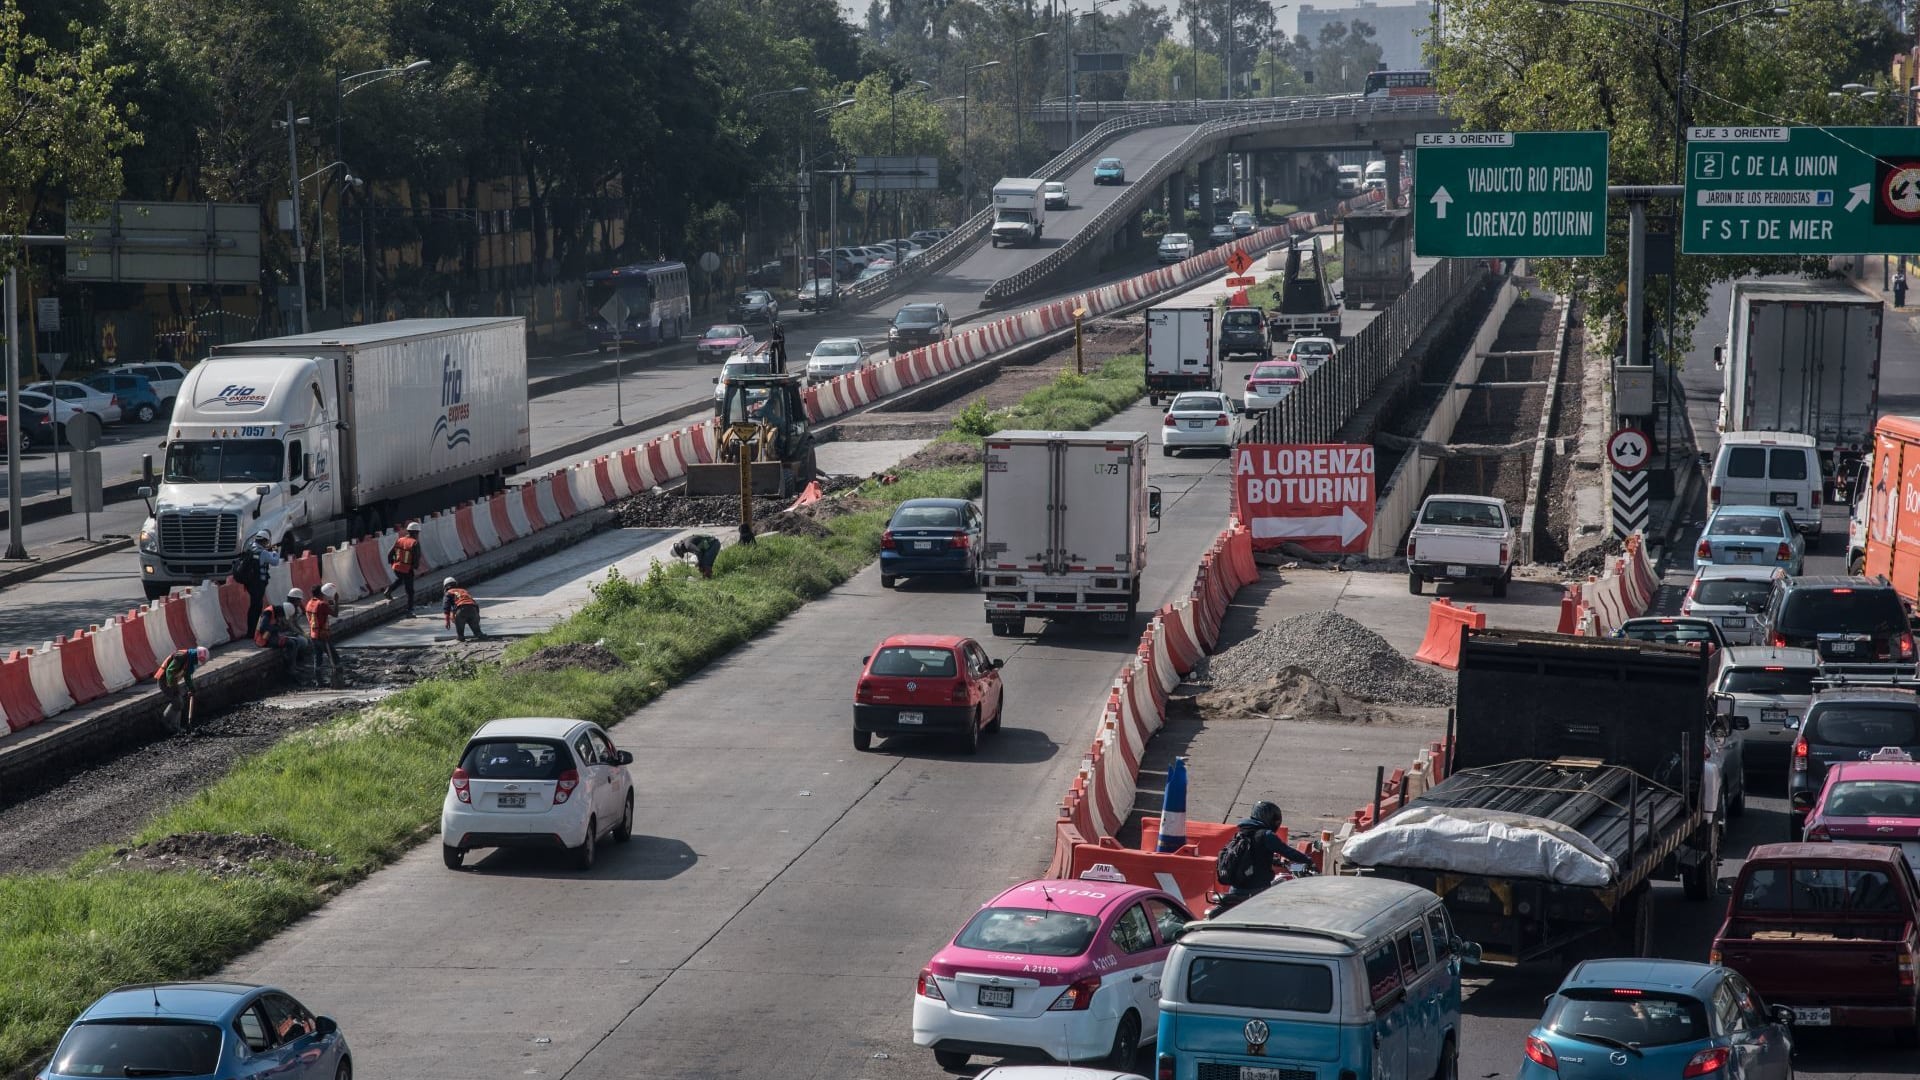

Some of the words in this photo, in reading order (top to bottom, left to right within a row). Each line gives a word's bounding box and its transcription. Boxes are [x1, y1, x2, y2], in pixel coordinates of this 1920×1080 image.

[1422, 135, 1443, 144] EJE
[1448, 136, 1456, 144] 3
[1460, 135, 1505, 144] ORIENTE
[1695, 129, 1716, 138] EJE
[1721, 129, 1729, 138] 3
[1734, 129, 1781, 138] ORIENTE
[1703, 159, 1716, 173] 2
[1731, 156, 1741, 176] C
[1747, 156, 1764, 176] DE
[1770, 156, 1789, 176] LA
[1795, 155, 1838, 176] UNION
[1468, 167, 1523, 192] VIADUCTO
[1528, 166, 1548, 192] RIO
[1553, 166, 1593, 192] PIEDAD
[1705, 192, 1732, 204] JARDIN
[1735, 192, 1745, 203] DE
[1747, 192, 1762, 203] LOS
[1764, 192, 1811, 203] PERIODISTAS
[1466, 211, 1527, 237] LORENZO
[1533, 211, 1593, 237] BOTURINI
[1702, 220, 1713, 240] F
[1720, 220, 1732, 240] S
[1740, 220, 1750, 240] T
[1757, 220, 1780, 240] DE
[1789, 220, 1833, 240] MIER
[448, 403, 470, 426] express
[241, 426, 265, 437] 7057
[1237, 448, 1257, 476] A
[1264, 447, 1375, 475] LORENZO
[1094, 464, 1118, 475] LT-73
[1247, 477, 1368, 504] BOTURINI
[1099, 613, 1126, 622] ISUZU
[1095, 864, 1111, 873] TAXI
[1023, 964, 1030, 972] A
[1032, 965, 1058, 974] 2113D
[1092, 960, 1100, 971] A
